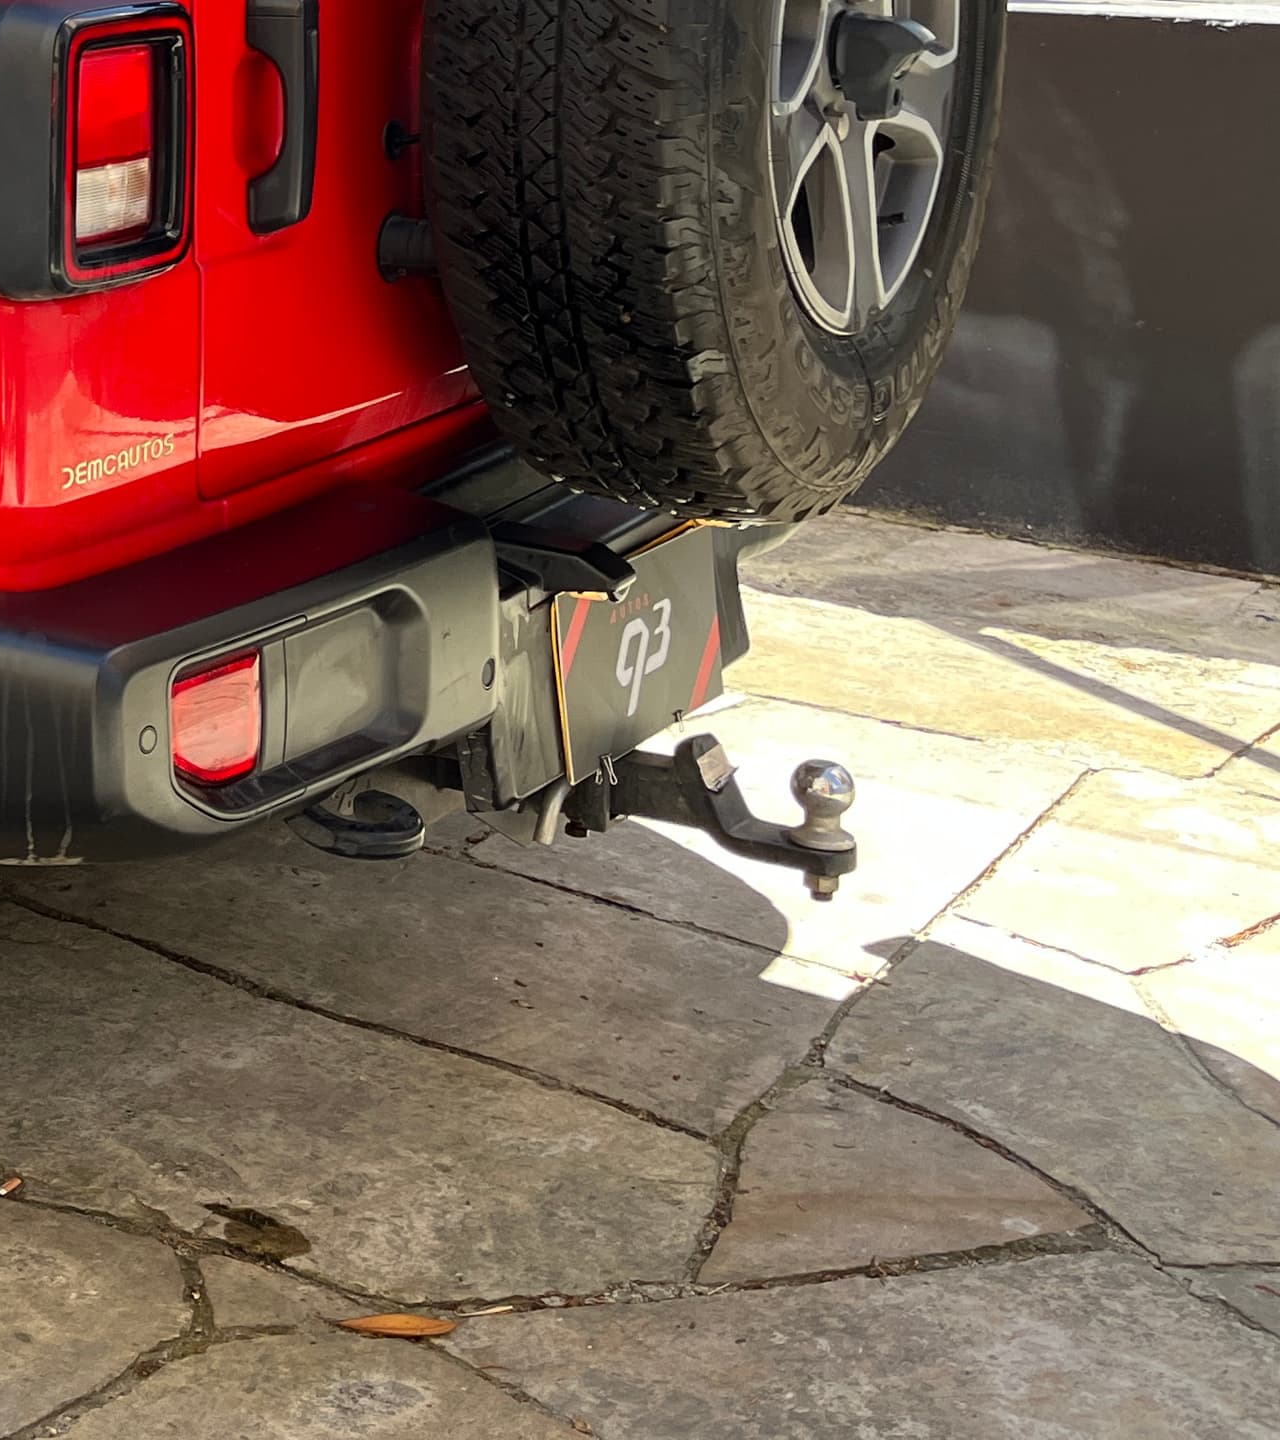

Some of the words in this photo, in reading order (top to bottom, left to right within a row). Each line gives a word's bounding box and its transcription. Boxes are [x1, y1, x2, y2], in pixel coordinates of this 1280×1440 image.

[61, 432, 175, 491] DEMCAUTOS
[609, 593, 650, 625] AUTOS
[615, 598, 672, 717] 93
